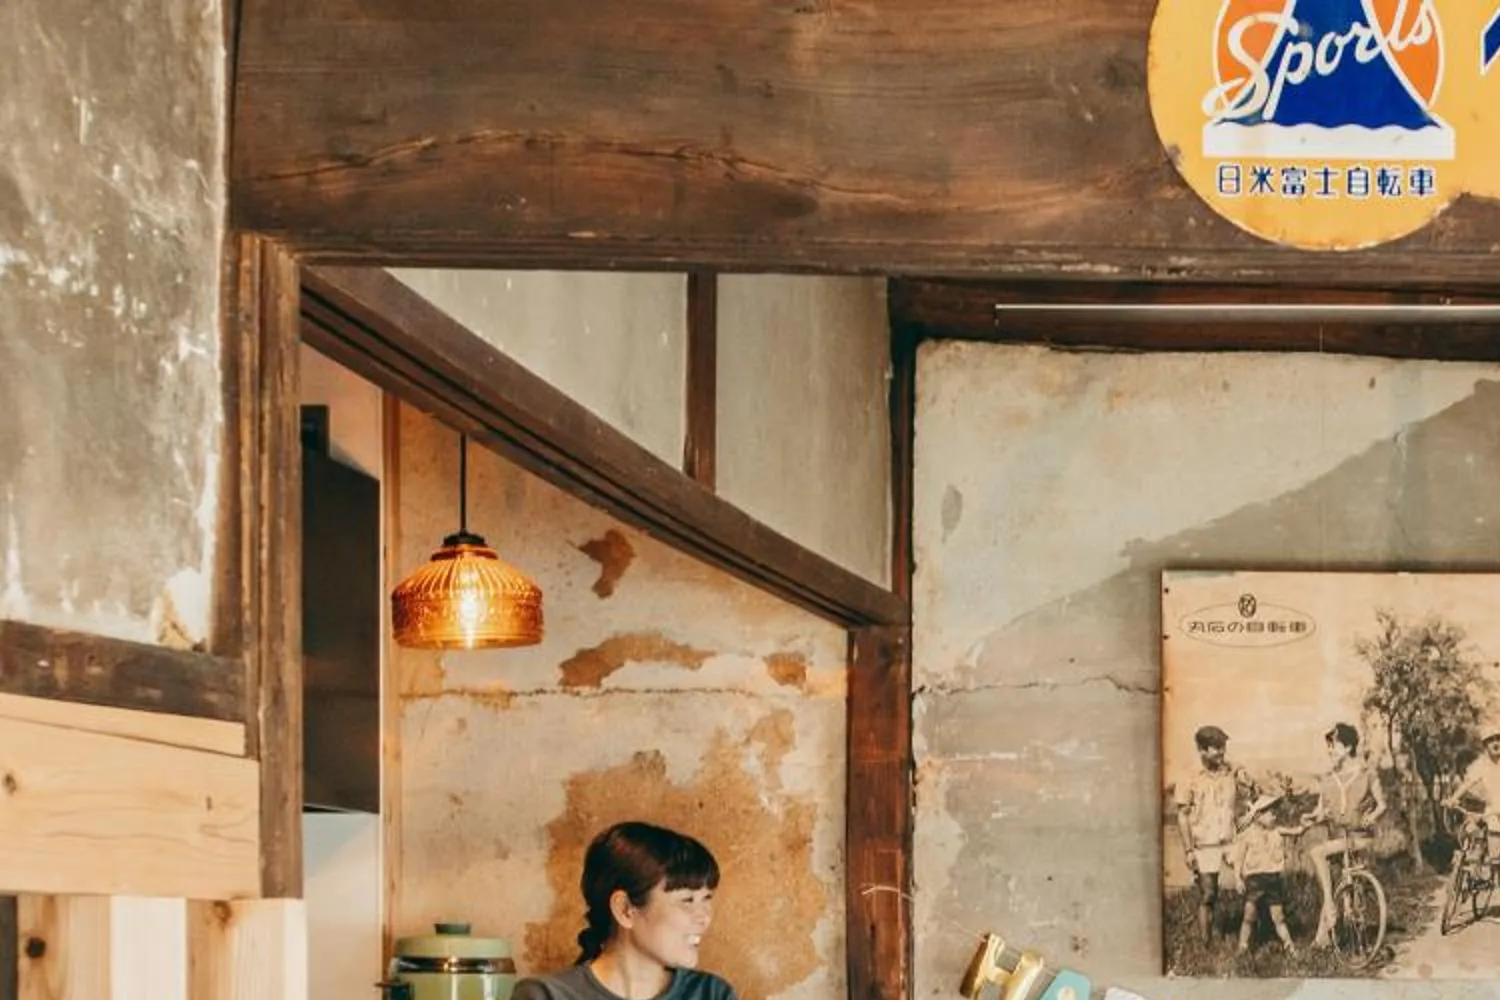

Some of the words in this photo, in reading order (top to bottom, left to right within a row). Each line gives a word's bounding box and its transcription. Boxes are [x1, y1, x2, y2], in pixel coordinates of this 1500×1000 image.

[1217, 164, 1436, 197] 日米富士自転車
